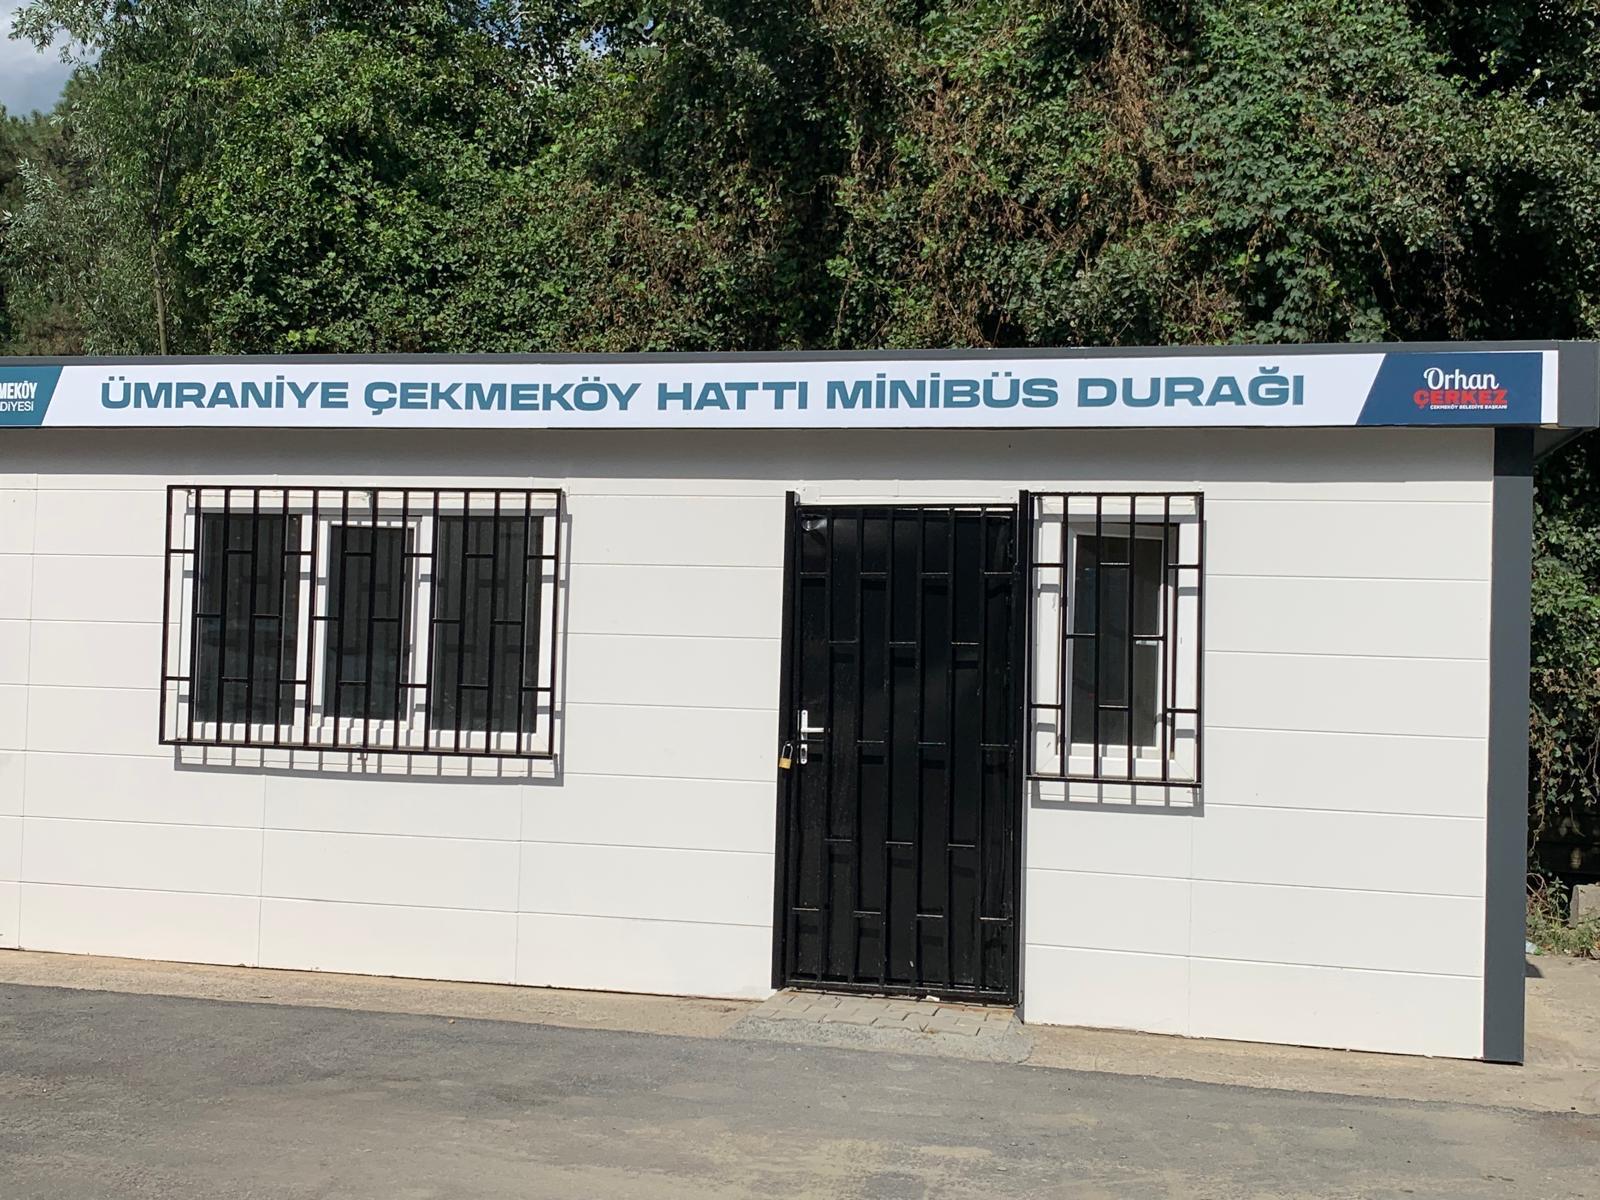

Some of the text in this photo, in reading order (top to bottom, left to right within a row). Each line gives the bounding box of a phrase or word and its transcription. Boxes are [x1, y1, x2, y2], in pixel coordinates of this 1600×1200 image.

[1423, 367, 1499, 390] Orhan
[102, 367, 1303, 415] ÜMRANİYE ÇEKMEKÖY HATTI MİNİBÜS DURAĞI
[1413, 389, 1508, 409] ÇERKEZ
